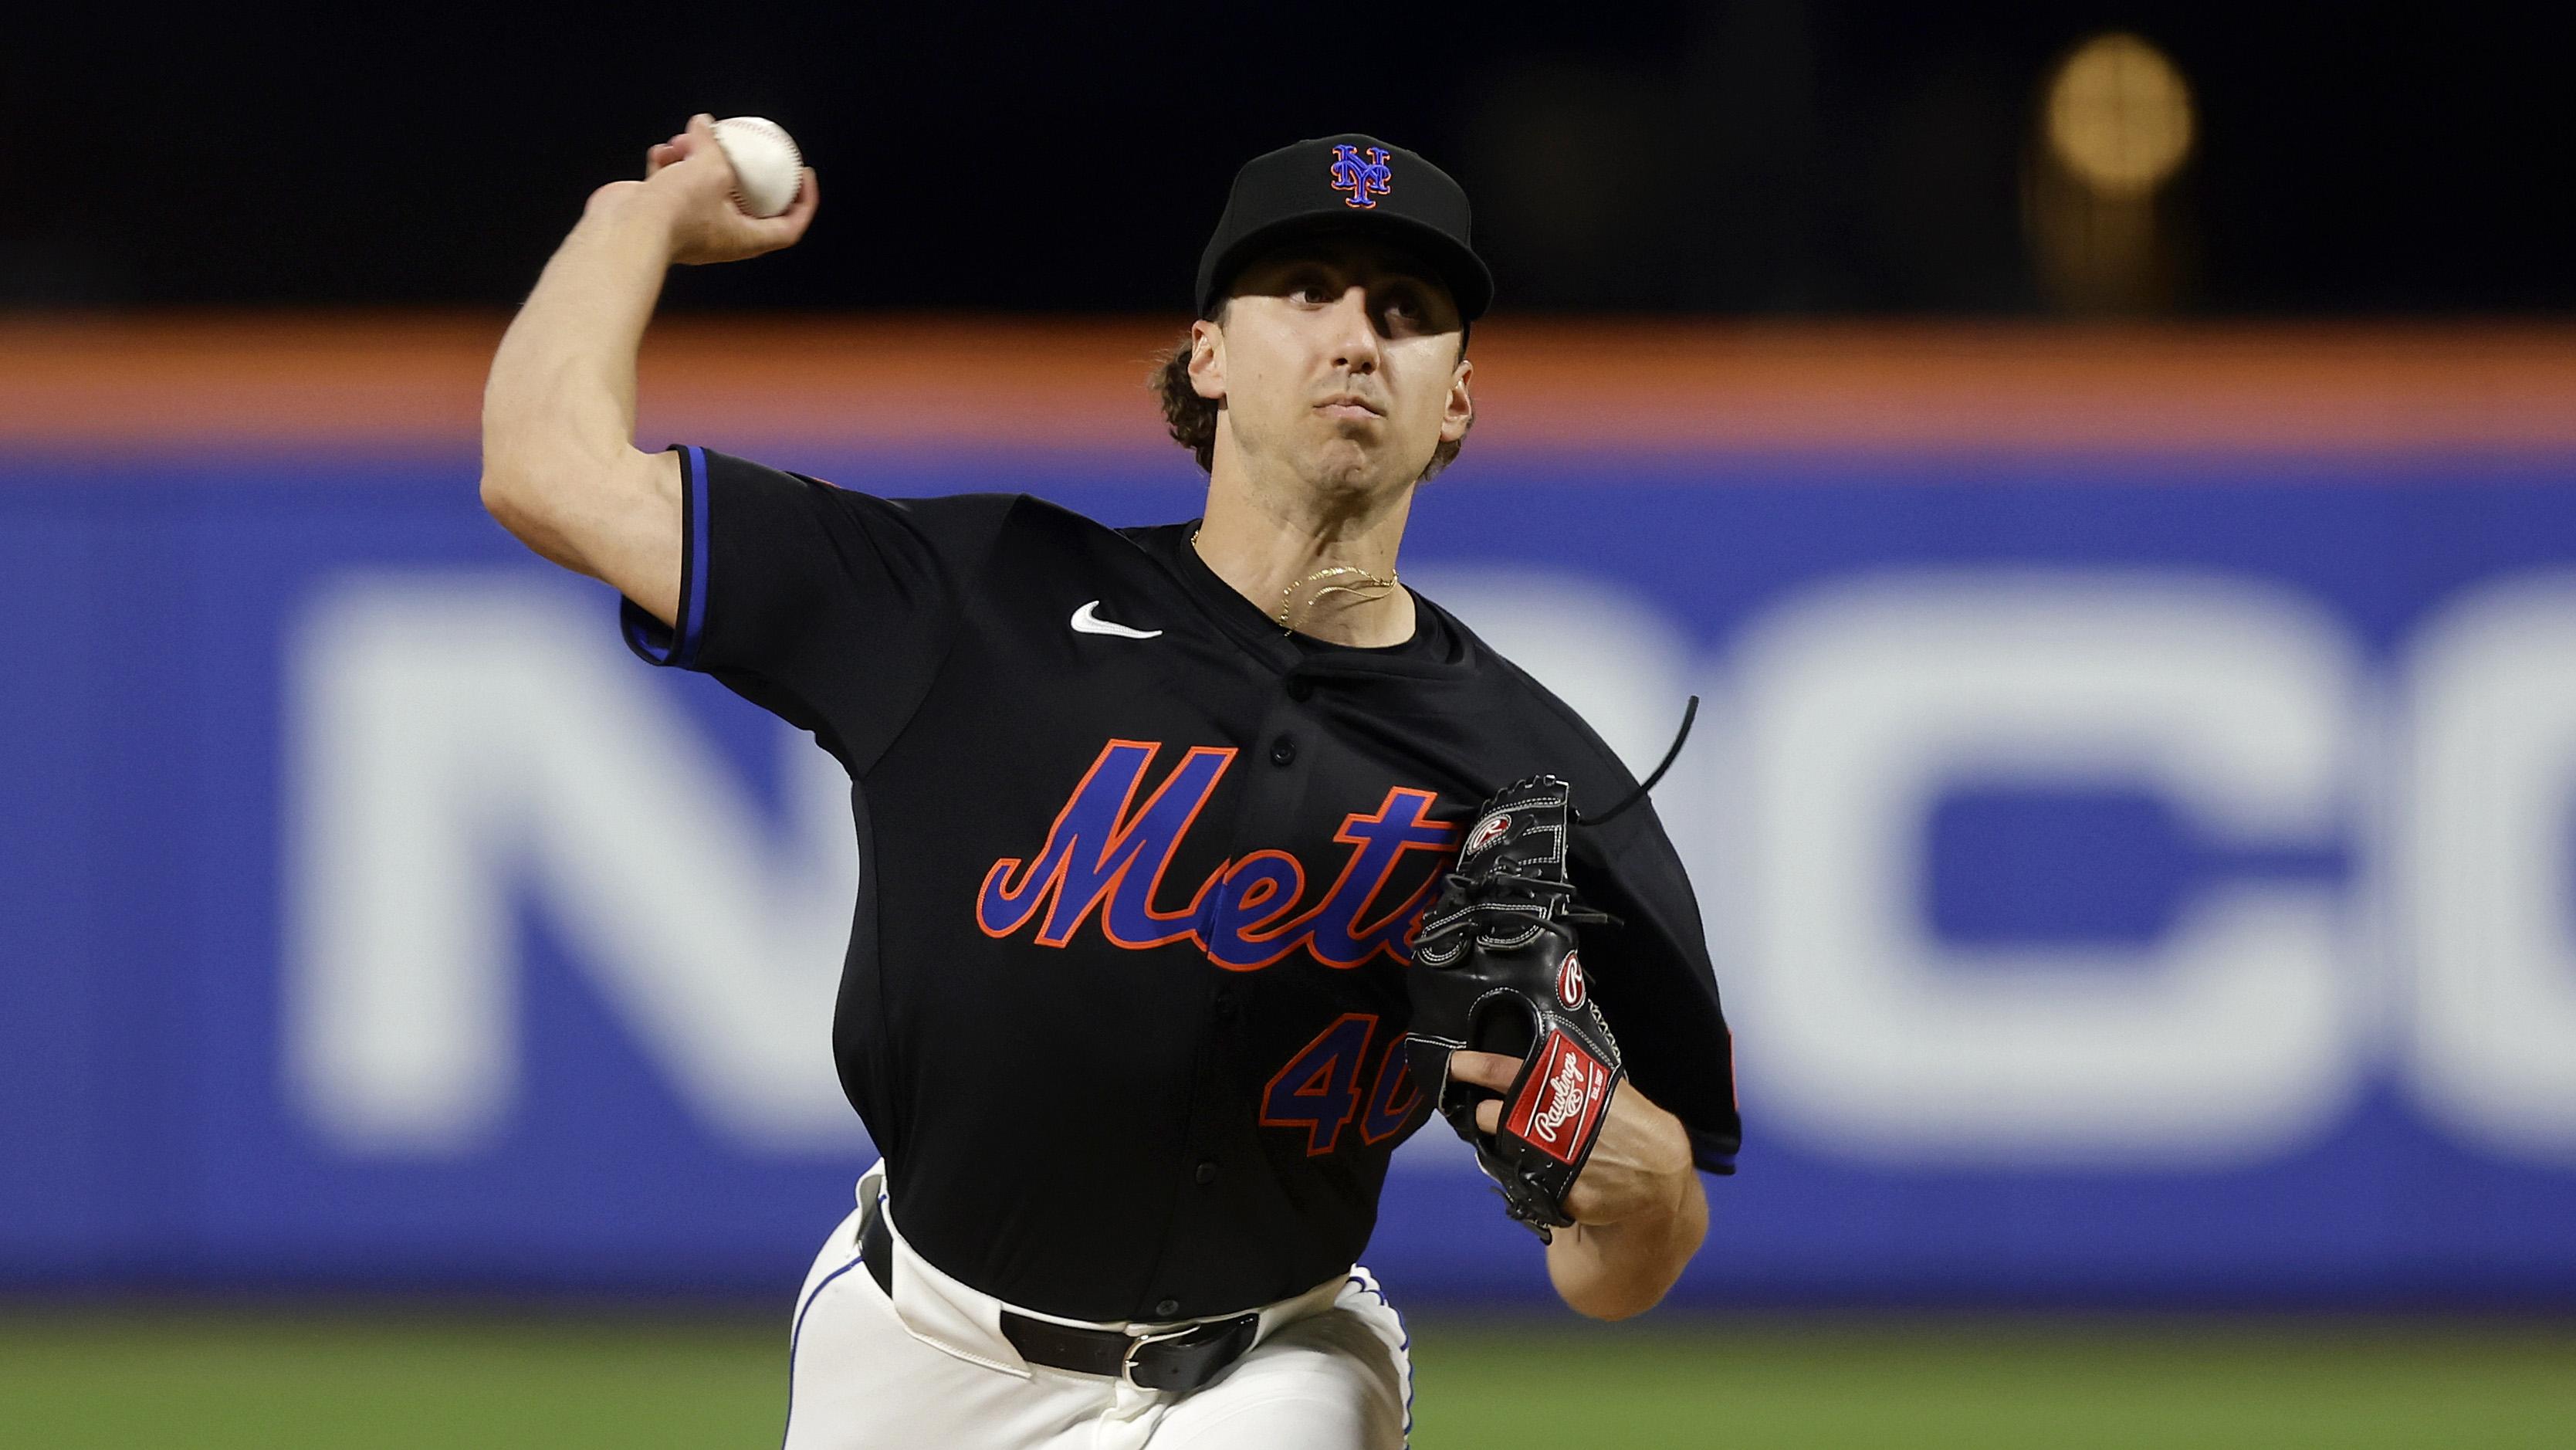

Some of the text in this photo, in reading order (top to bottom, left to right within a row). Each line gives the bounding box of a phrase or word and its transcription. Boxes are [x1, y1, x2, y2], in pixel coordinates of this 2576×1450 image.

[1473, 818, 1504, 849] R
[286, 567, 2576, 1170] NC
[1565, 957, 1582, 1004] R
[1534, 1052, 1584, 1143] Rawlings
